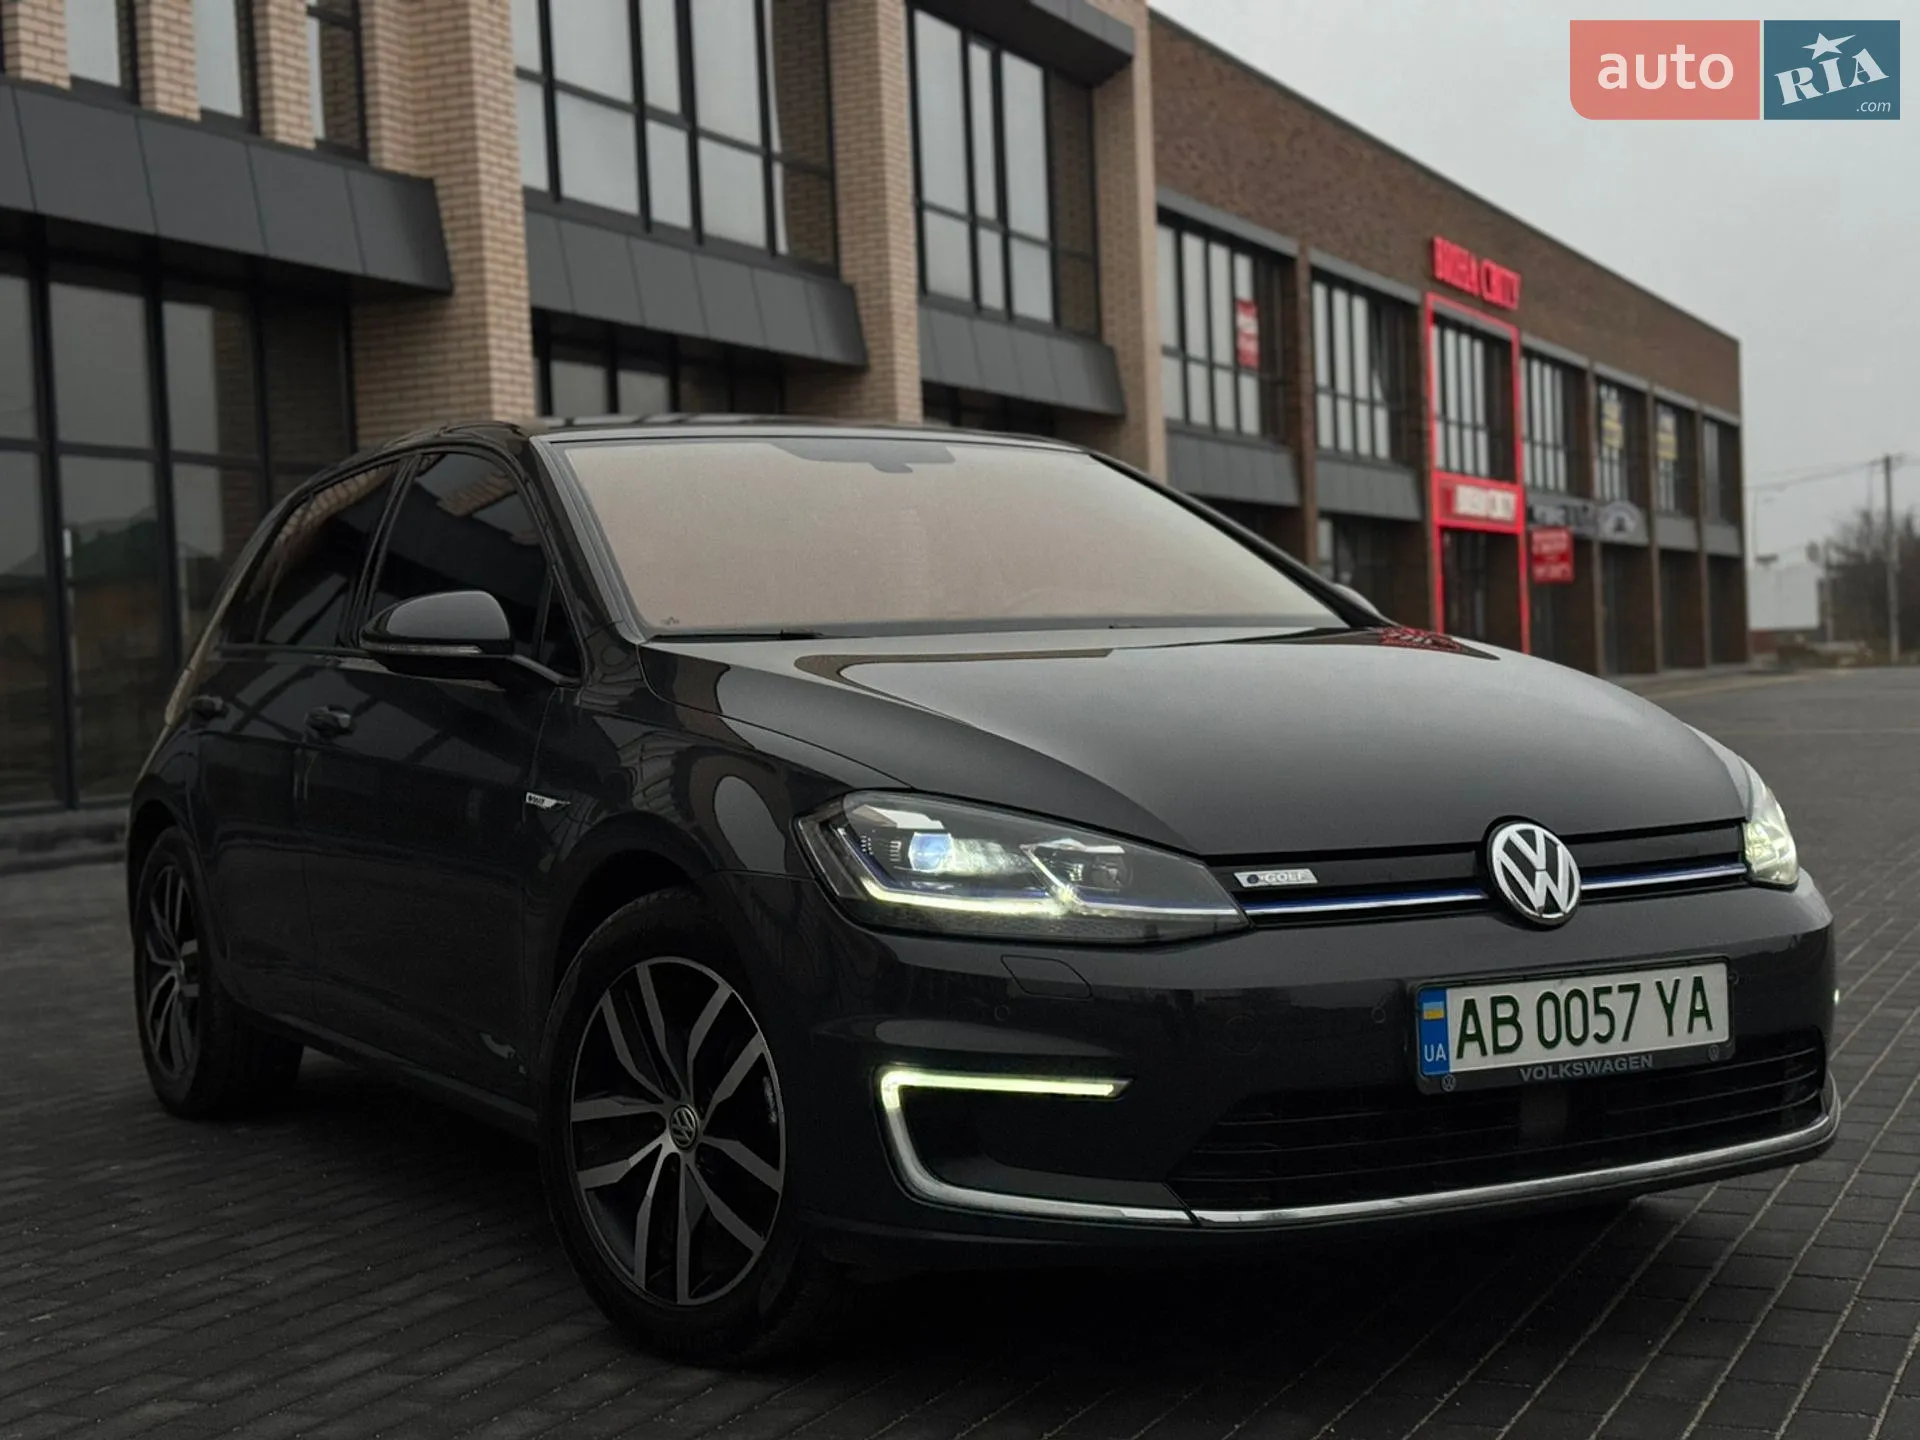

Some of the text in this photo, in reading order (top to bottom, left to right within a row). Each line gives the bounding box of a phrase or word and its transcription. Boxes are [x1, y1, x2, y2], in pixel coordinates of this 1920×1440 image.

[1456, 975, 1713, 1058] AB 0057 YA
[1424, 1043, 1447, 1062] UA
[1519, 1053, 1654, 1082] VOLKSWAGEN
